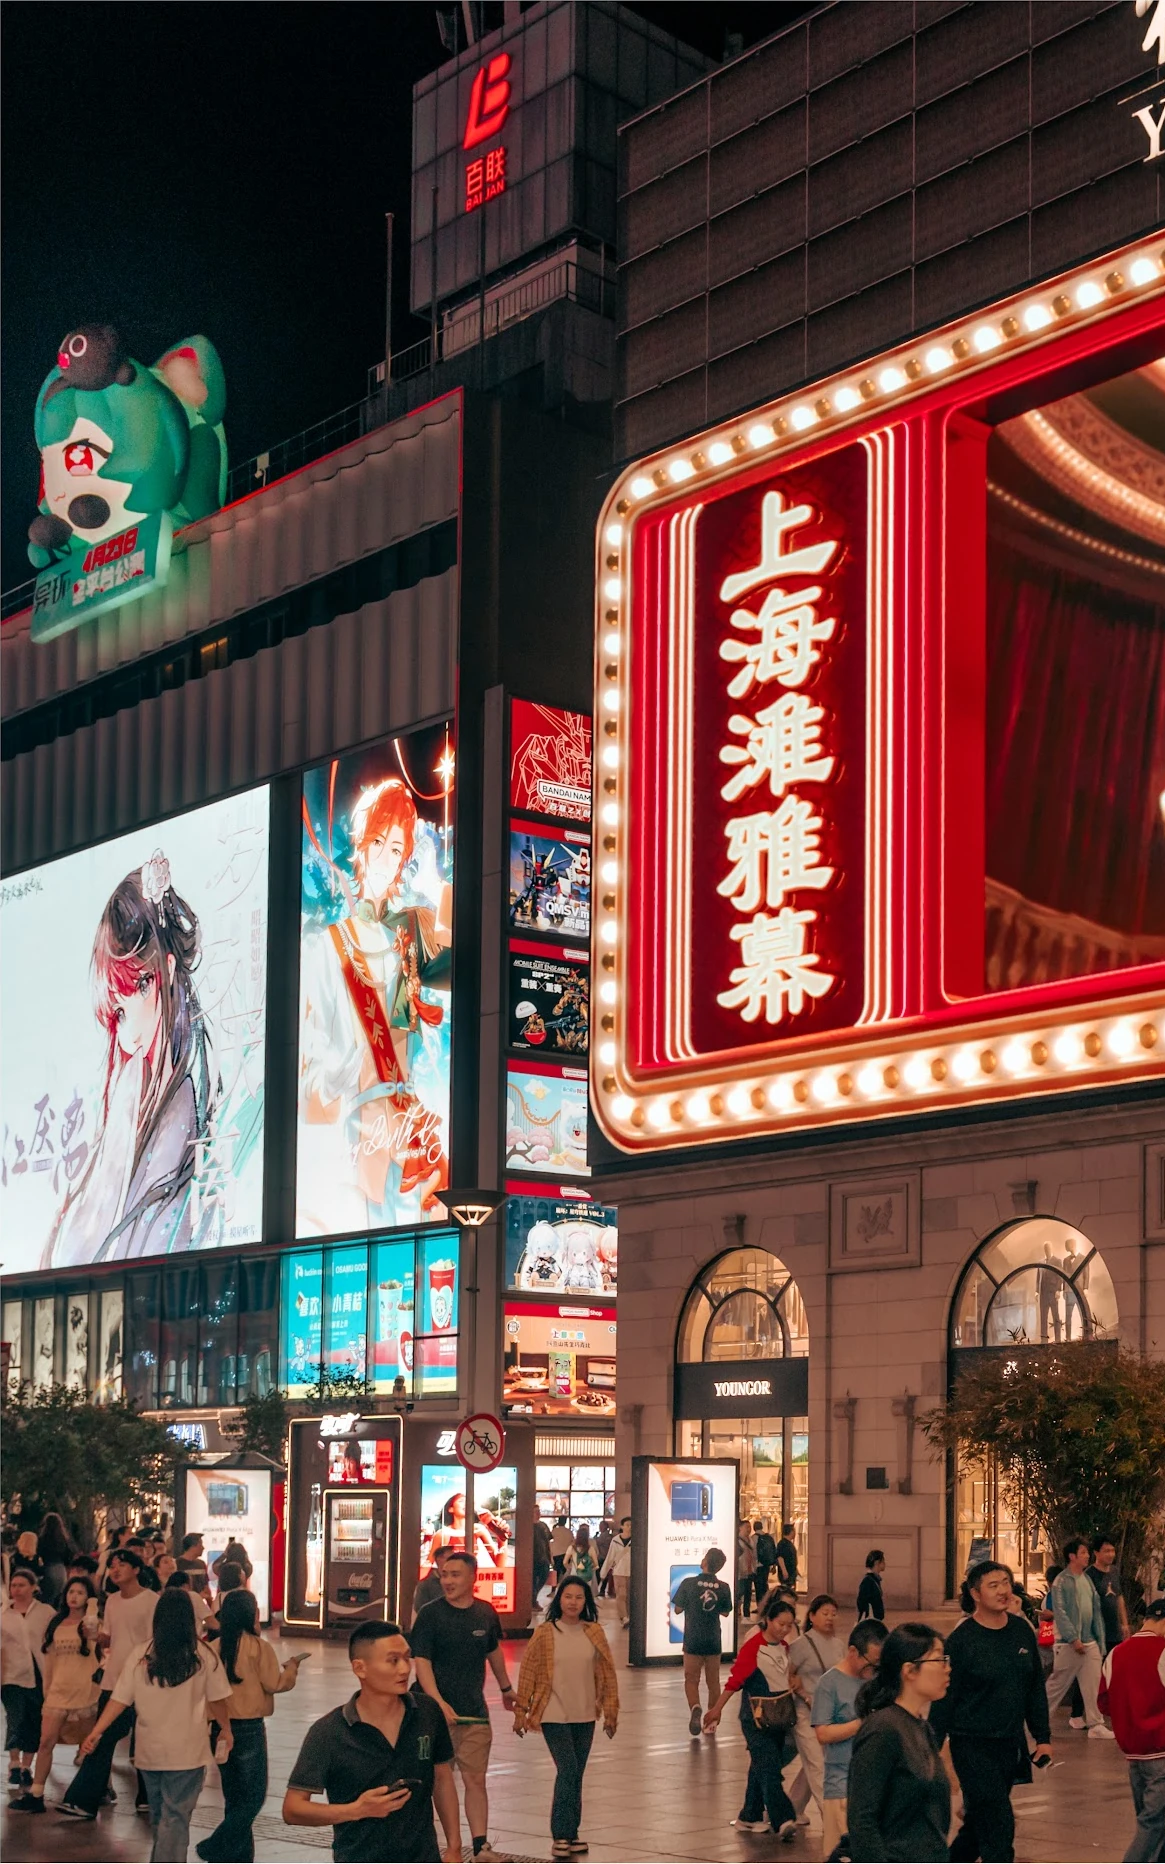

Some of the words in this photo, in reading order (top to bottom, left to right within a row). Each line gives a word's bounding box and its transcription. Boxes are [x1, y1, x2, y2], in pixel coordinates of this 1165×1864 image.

[466, 147, 506, 196] 百联
[717, 490, 838, 1025] 上海滩雅幕
[542, 784, 573, 799] BANDAI
[546, 902, 580, 916] QMSV
[299, 1295, 322, 1317] 喜欢
[590, 1309, 603, 1317] Shop
[714, 1379, 772, 1397] YOUNGOR
